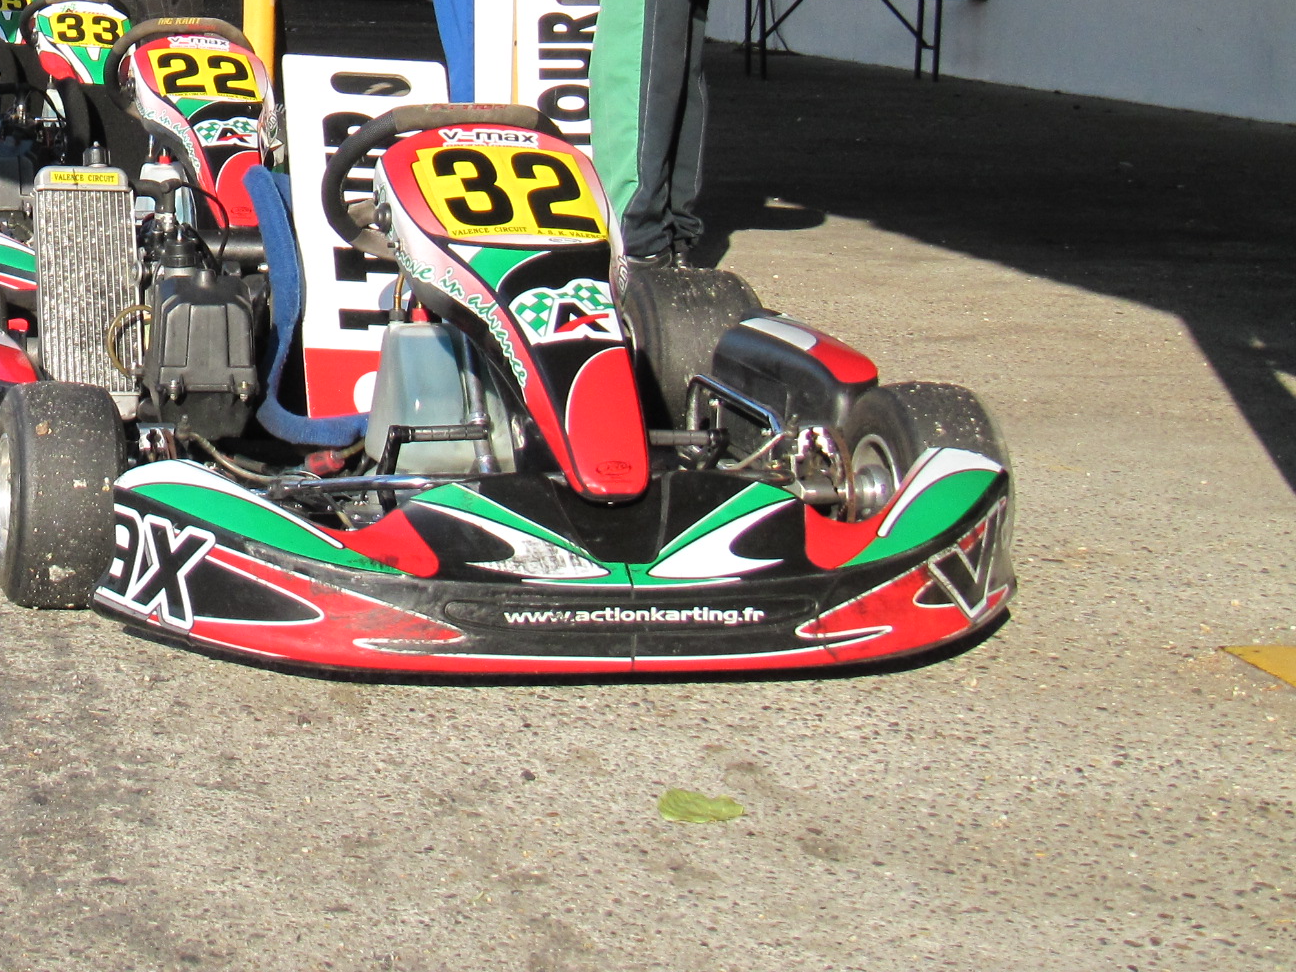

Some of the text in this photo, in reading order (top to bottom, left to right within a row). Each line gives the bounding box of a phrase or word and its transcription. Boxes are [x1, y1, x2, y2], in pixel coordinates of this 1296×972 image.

[56, 13, 120, 45] 33
[157, 52, 256, 98] 22
[442, 130, 535, 144] v-max
[54, 173, 115, 182] VALENCE CIRCUIT
[432, 148, 602, 234] 32
[452, 227, 490, 236] VALENCE
[395, 250, 528, 387] move in advance
[503, 606, 765, 626] www.actionkarting.fr
